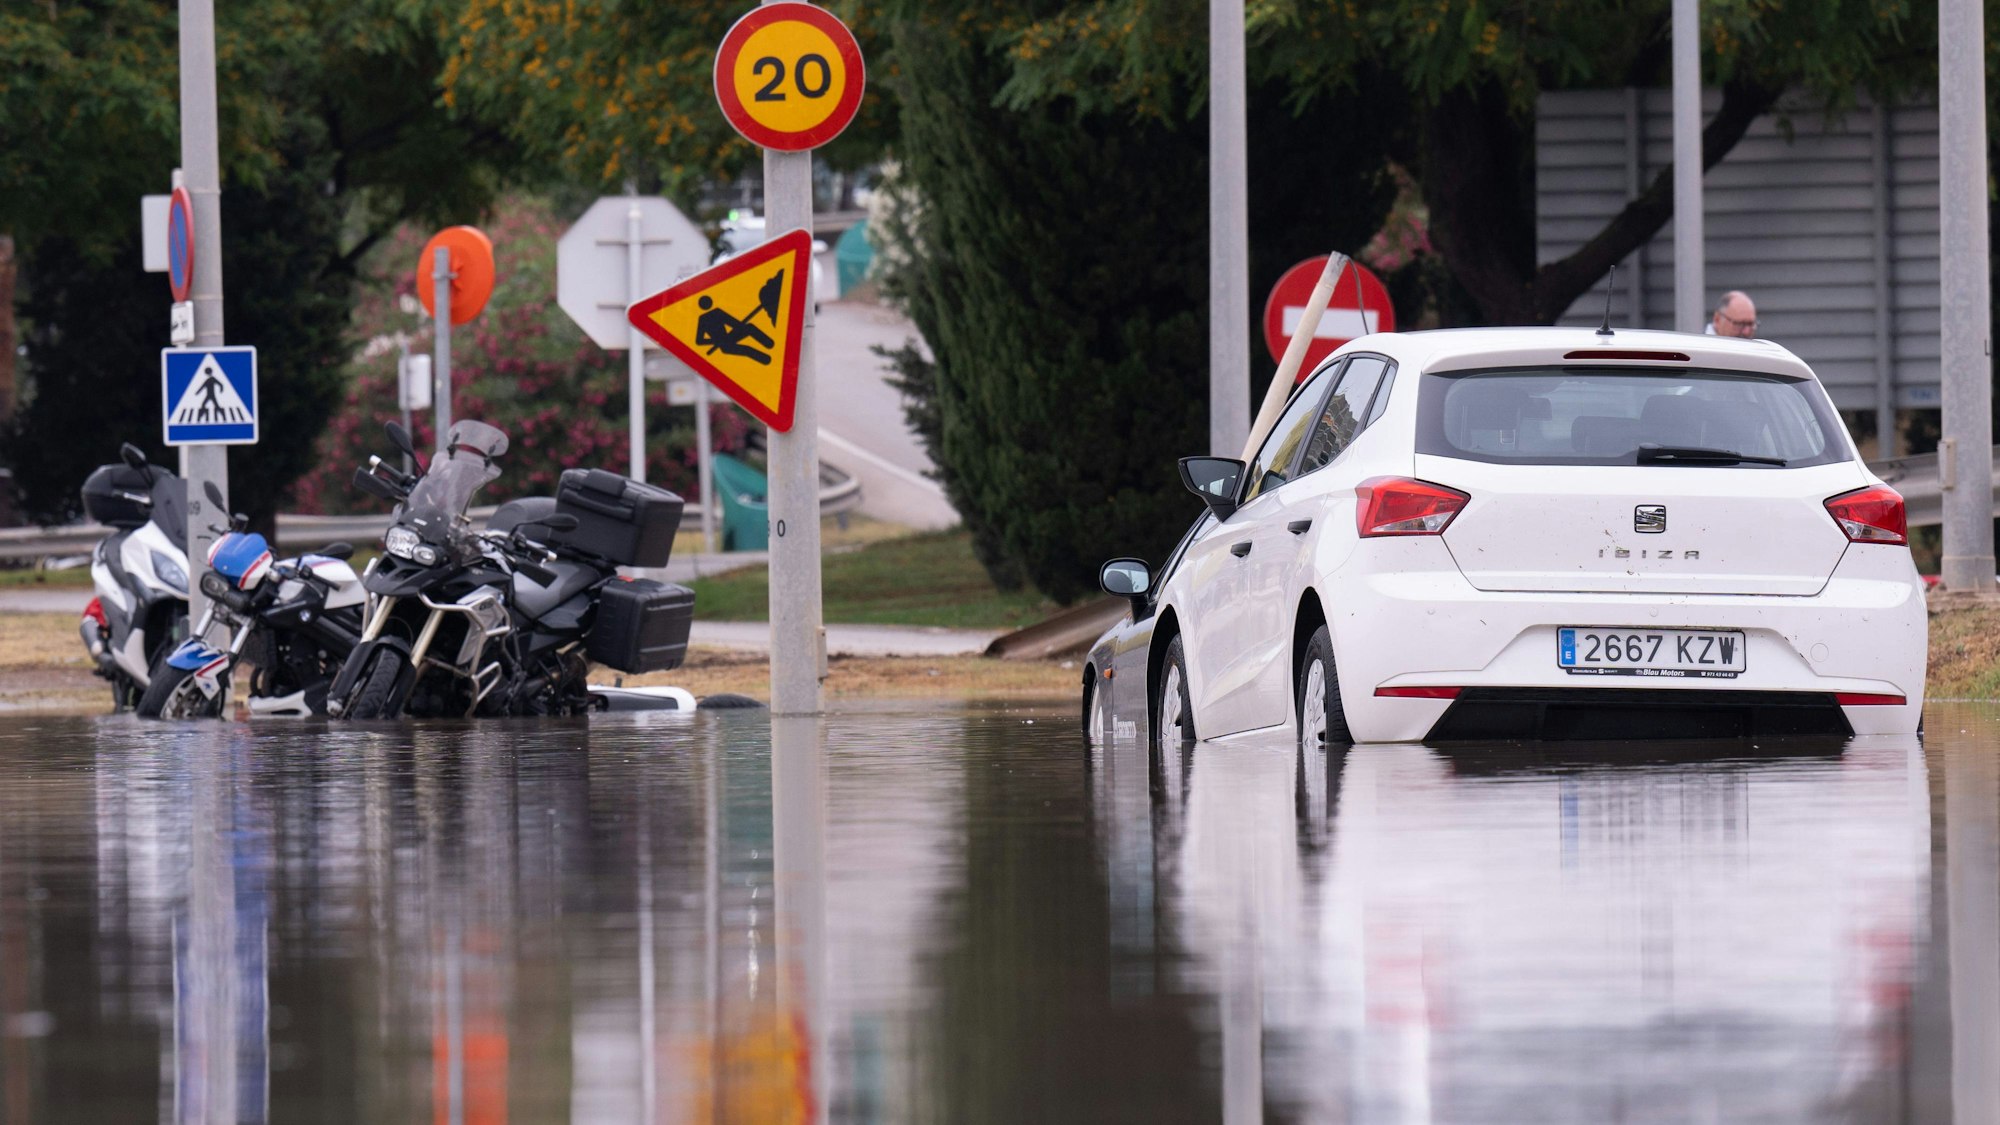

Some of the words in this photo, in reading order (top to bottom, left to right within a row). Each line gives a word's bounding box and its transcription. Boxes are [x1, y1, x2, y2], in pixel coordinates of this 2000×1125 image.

[753, 53, 831, 102] 20
[1599, 549, 1699, 559] IBIZA
[1565, 651, 1572, 659] E
[1584, 634, 1663, 663] 2667
[1677, 635, 1735, 664] KZW
